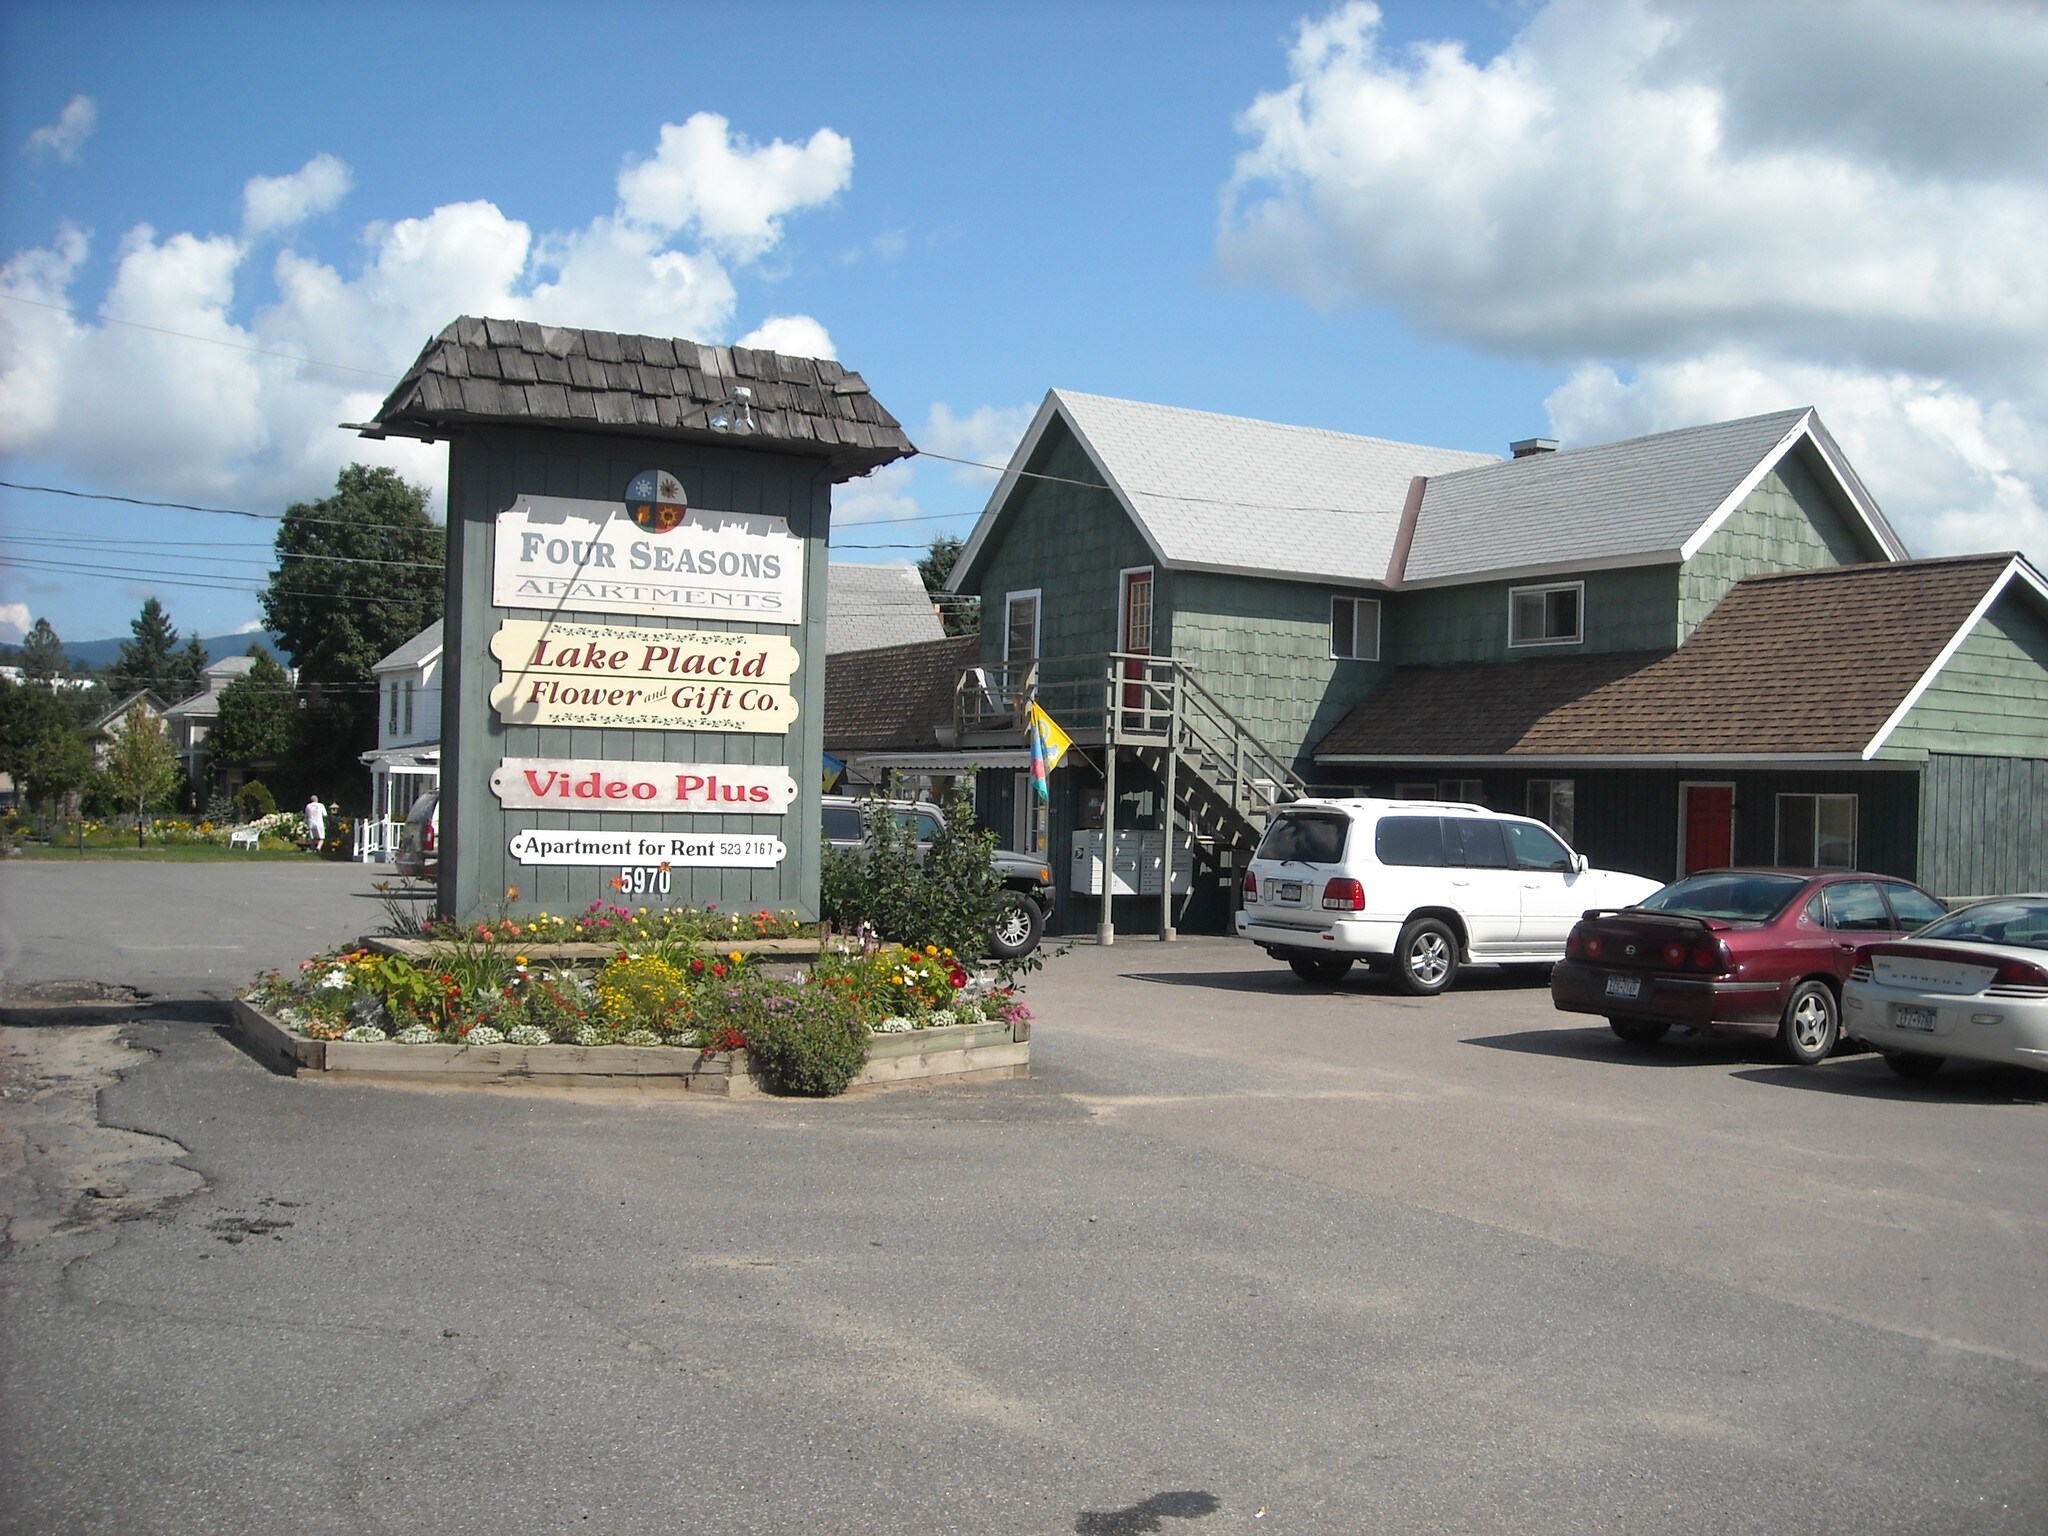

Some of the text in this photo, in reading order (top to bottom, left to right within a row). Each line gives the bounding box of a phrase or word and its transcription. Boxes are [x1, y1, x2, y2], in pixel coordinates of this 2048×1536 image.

[520, 532, 781, 579] FOUR SEASONS
[517, 580, 782, 608] APARTMENTS
[529, 640, 768, 677] Lake Placid
[527, 681, 779, 715] Flower and Gift Co.
[524, 770, 770, 802] Video Plus
[524, 837, 631, 856] Apartment
[638, 839, 664, 855] for
[671, 840, 715, 856] Rent
[720, 843, 741, 855] 523
[621, 867, 671, 894] 5970
